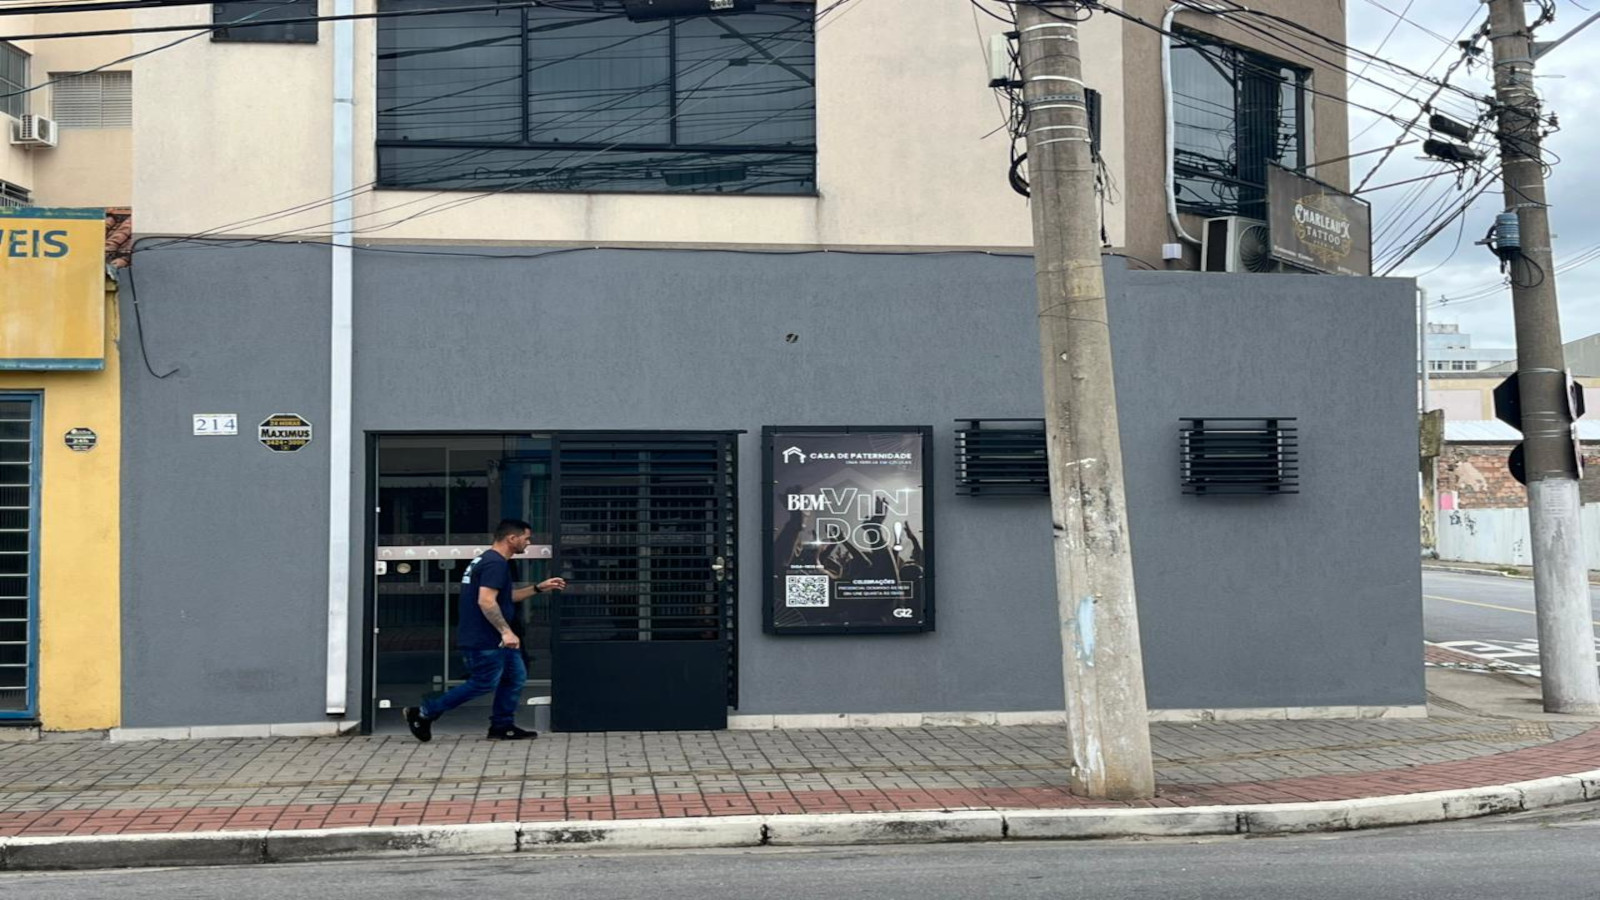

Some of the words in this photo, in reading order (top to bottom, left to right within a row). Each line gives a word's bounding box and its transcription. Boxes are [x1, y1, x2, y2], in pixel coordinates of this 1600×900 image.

[1306, 226, 1341, 245] TATTOO
[0, 229, 68, 258] EIS
[196, 418, 235, 431] 214
[261, 428, 310, 438] MAXIMUS
[809, 452, 836, 460] CASA
[837, 452, 849, 460] DE
[850, 452, 912, 460] PATERNIDADE
